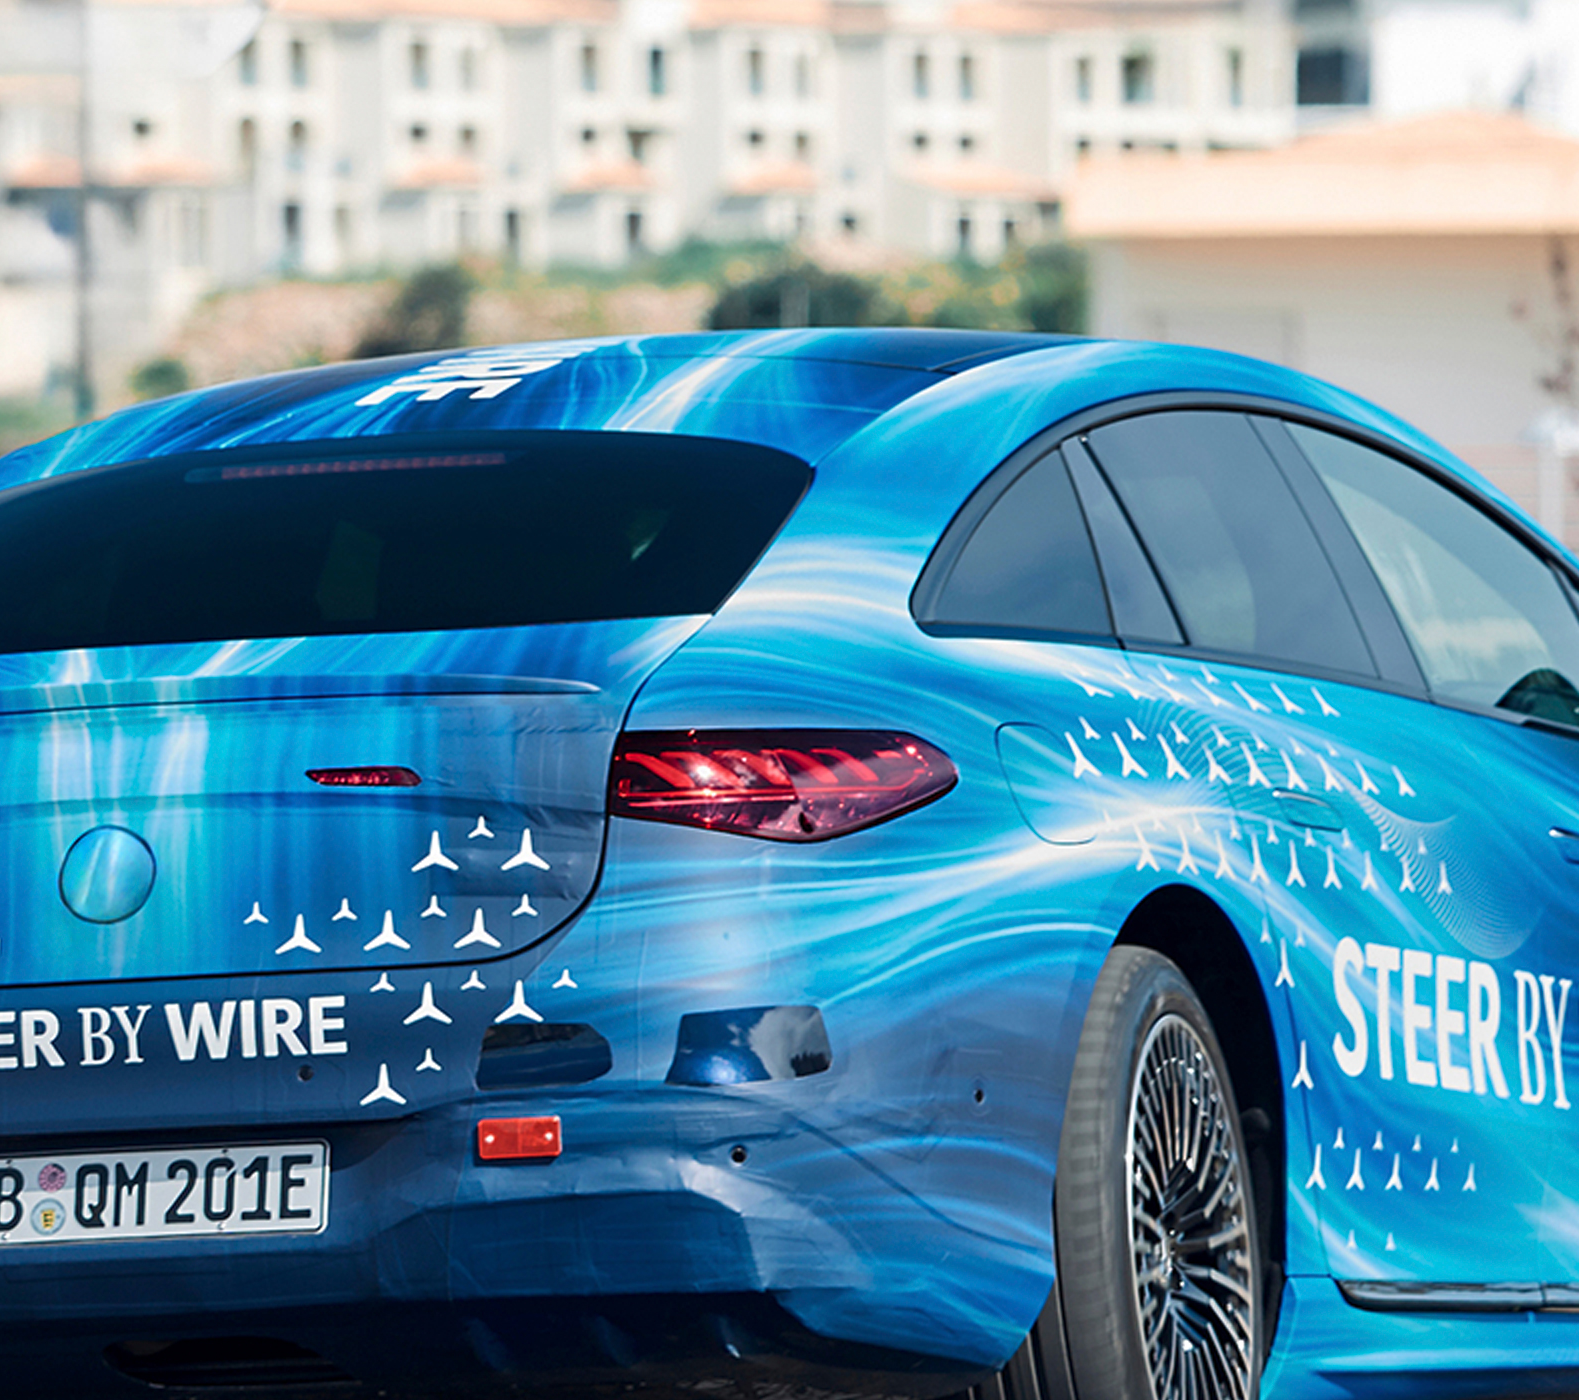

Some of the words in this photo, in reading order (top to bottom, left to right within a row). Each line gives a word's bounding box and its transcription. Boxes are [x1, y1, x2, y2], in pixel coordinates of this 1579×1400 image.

[77, 1004, 152, 1067] BY
[164, 995, 349, 1061] WIRE
[1331, 935, 1511, 1100] STEER
[1513, 969, 1573, 1111] BY
[74, 1160, 151, 1229] QM
[164, 1153, 315, 1225] 201E
